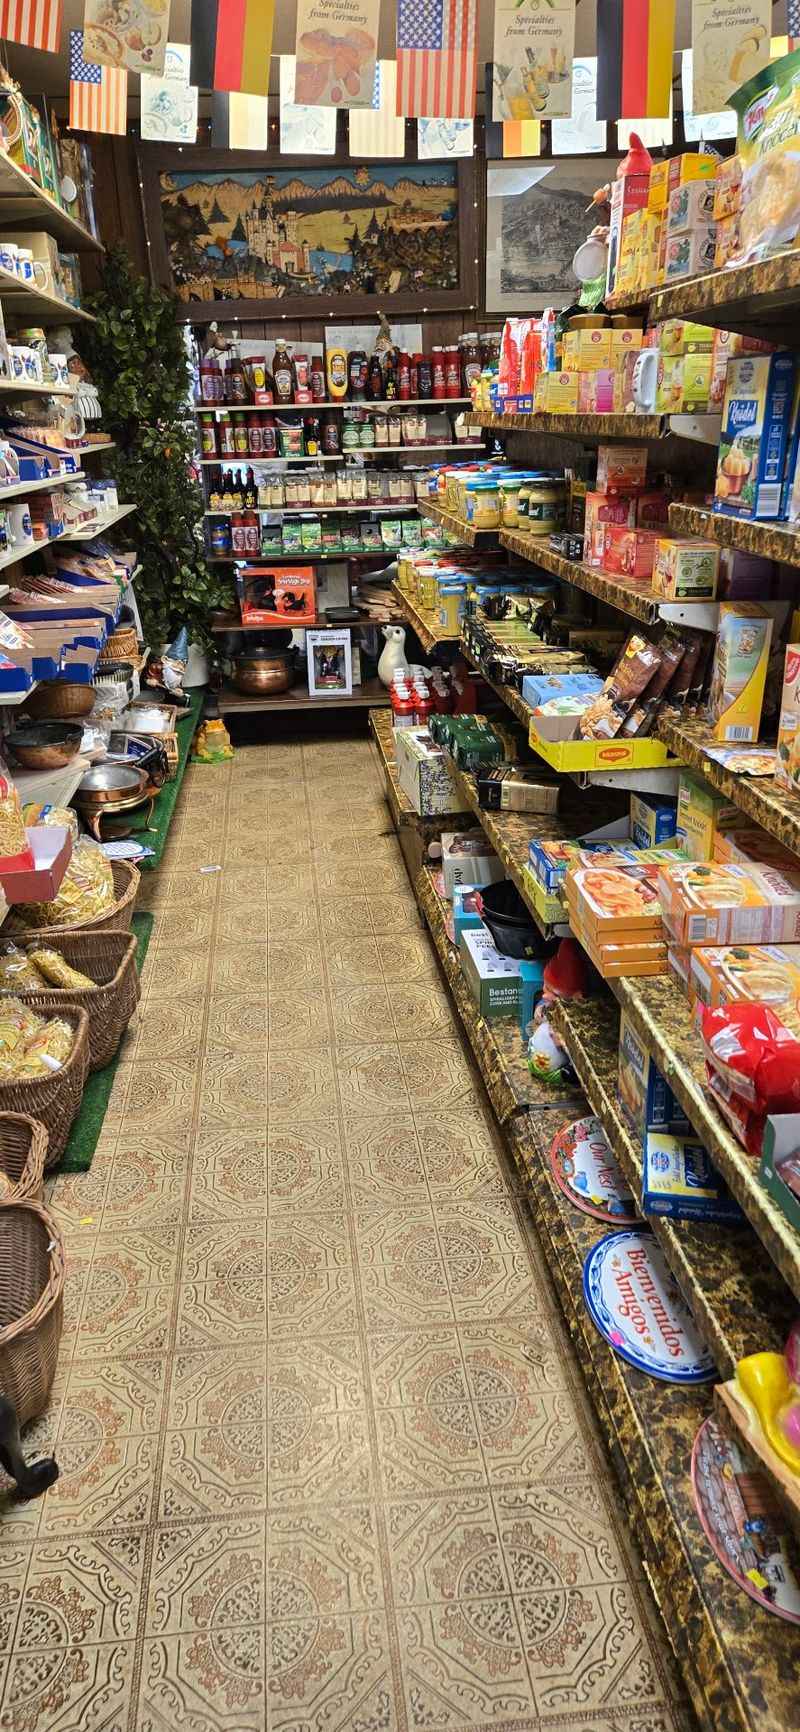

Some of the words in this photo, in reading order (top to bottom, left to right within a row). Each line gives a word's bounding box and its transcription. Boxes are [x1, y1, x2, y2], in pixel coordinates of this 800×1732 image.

[307, 7, 329, 19] from
[331, 10, 369, 26] Germany
[514, 14, 556, 26] Specialties
[711, 6, 752, 19] Specialties
[504, 26, 525, 38] from
[527, 26, 563, 40] Germany
[702, 19, 722, 33] from
[724, 16, 760, 29] Germany
[589, 1142, 608, 1168] Our
[597, 1167, 618, 1191] Nest
[612, 1268, 651, 1335] Amigos
[627, 1247, 685, 1357] Bienvenidos
